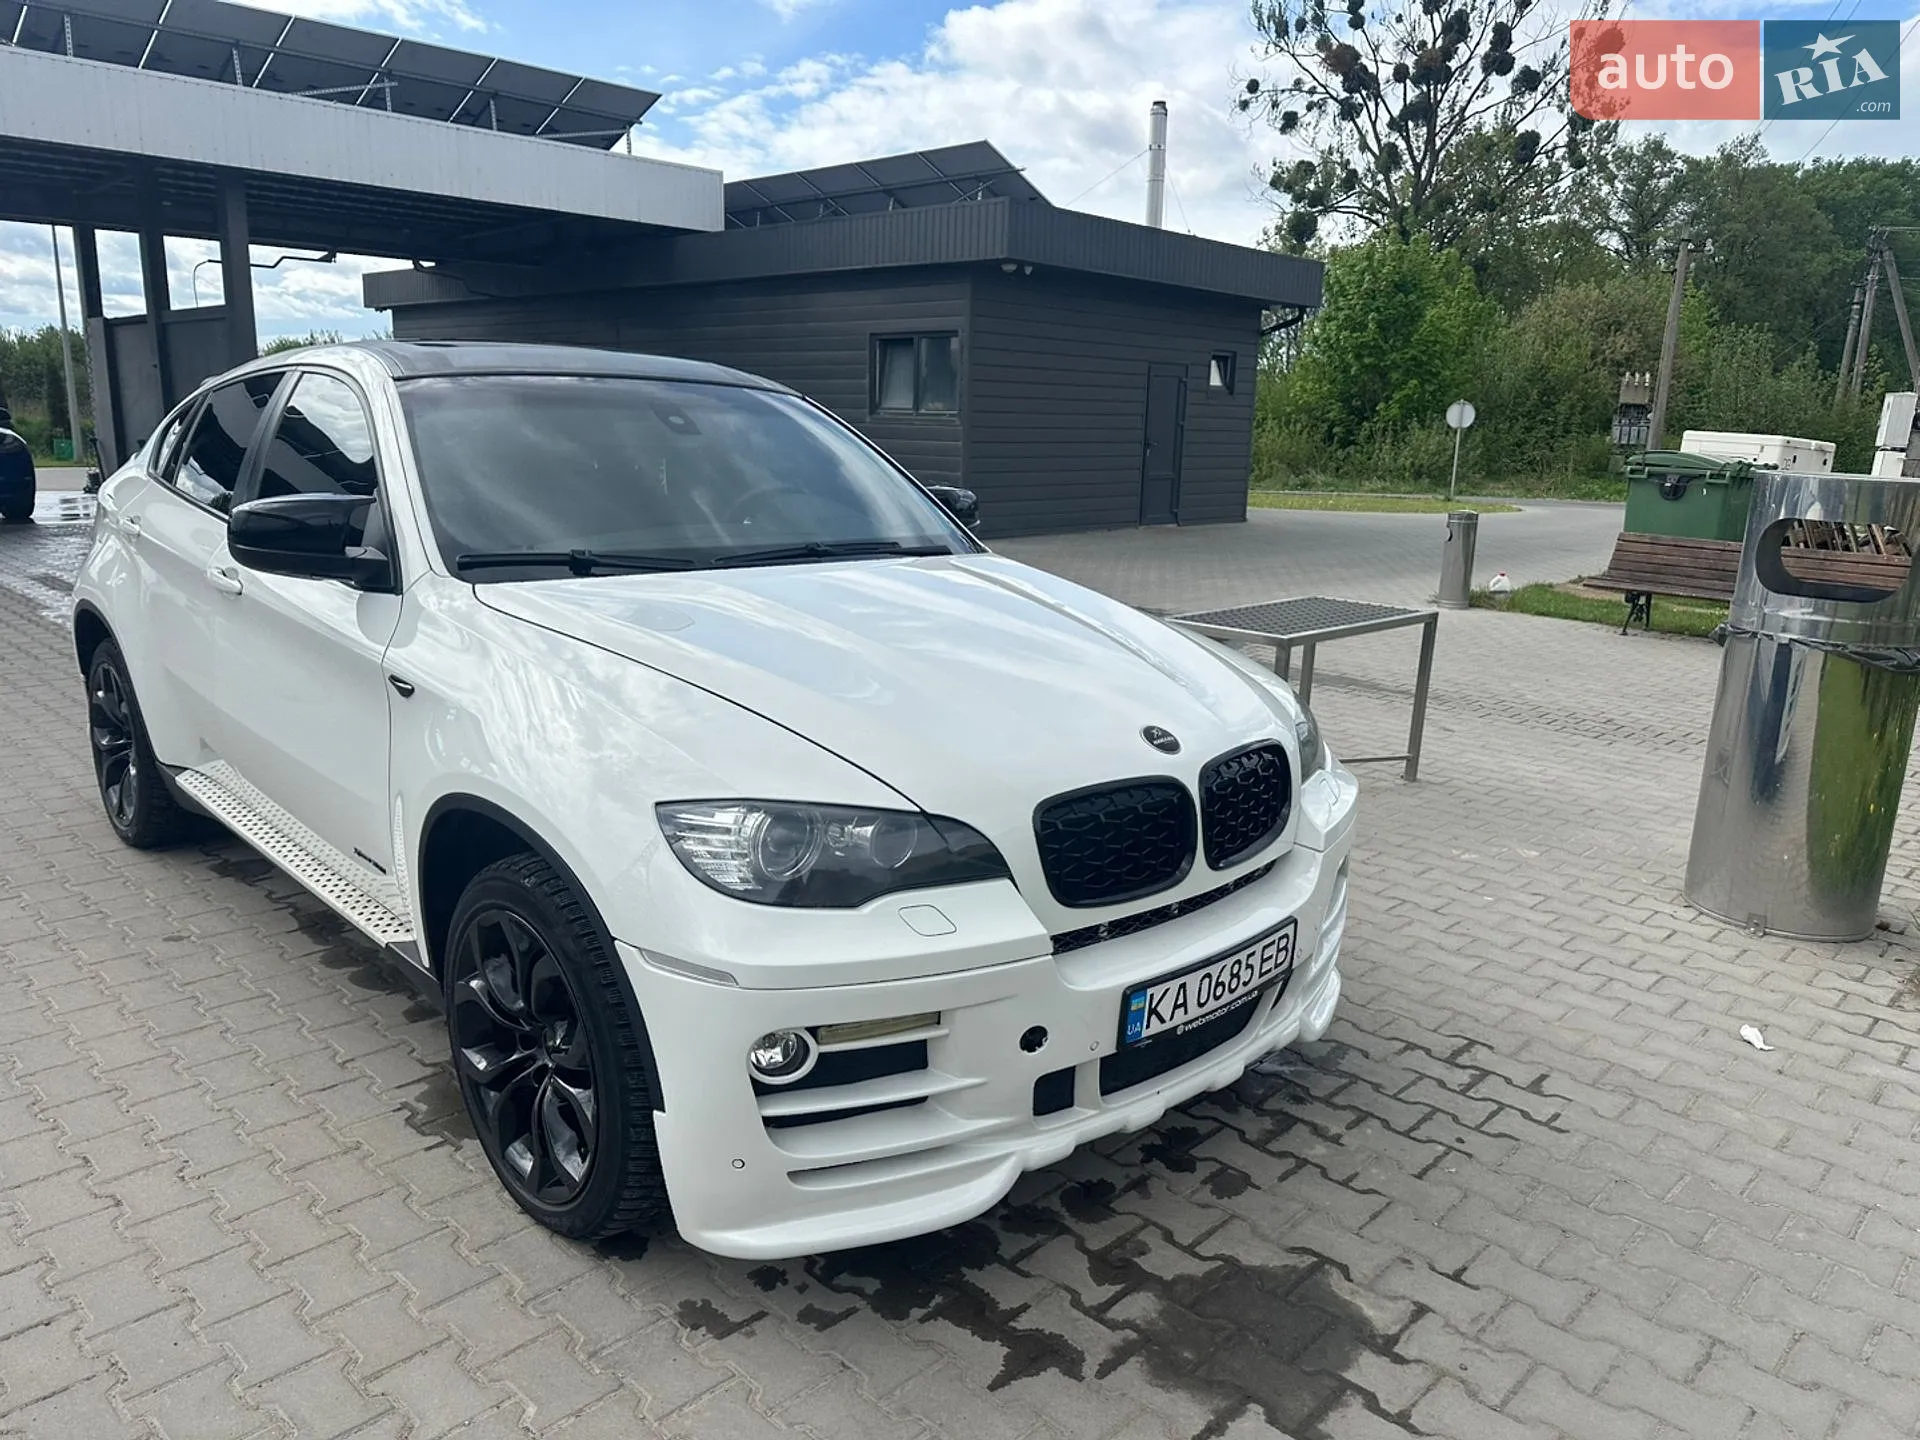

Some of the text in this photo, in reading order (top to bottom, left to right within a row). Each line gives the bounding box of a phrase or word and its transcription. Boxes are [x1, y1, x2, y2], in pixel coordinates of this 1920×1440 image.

[1145, 933, 1290, 1030] KA 0685 EB
[1127, 1021, 1142, 1036] UA
